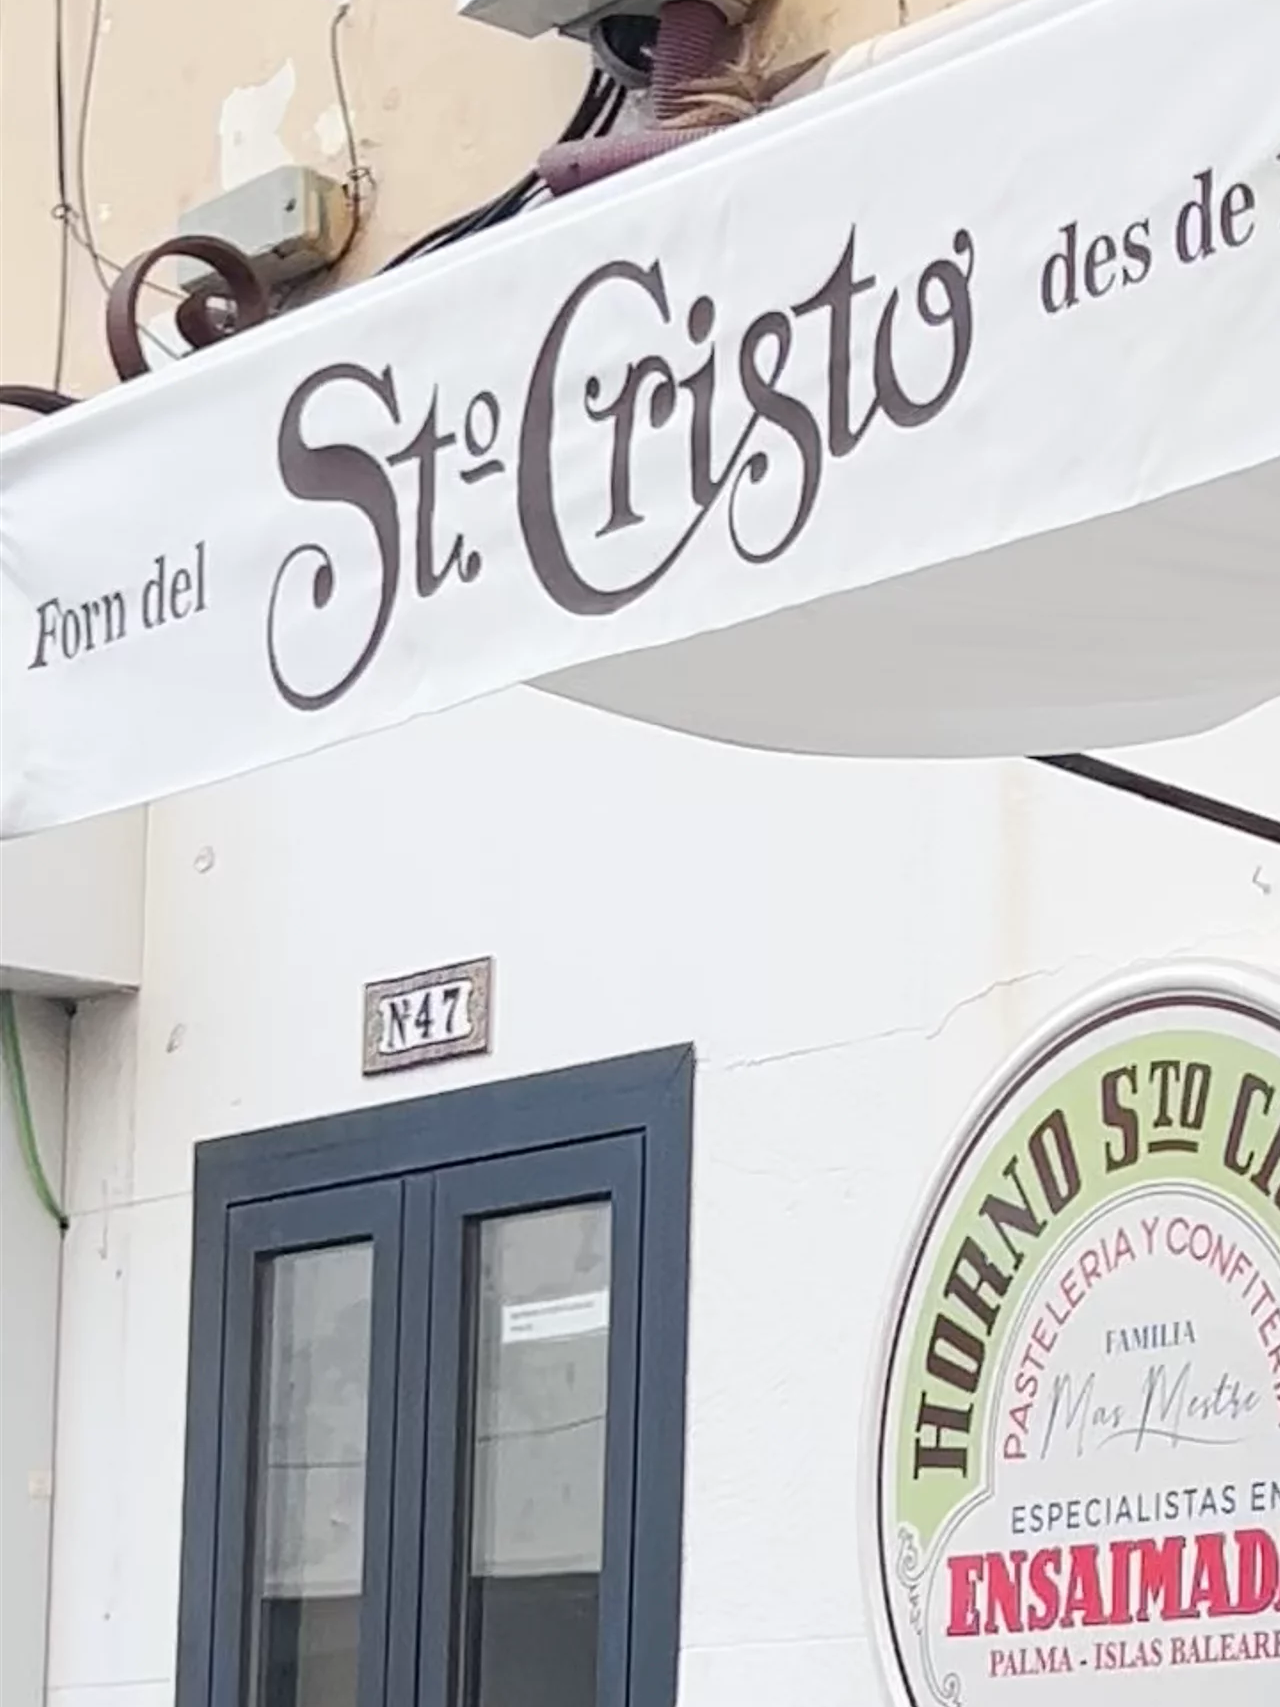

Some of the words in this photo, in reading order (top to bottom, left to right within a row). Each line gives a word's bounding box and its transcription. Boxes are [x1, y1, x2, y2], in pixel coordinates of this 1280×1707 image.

[28, 596, 126, 670] Forn
[142, 540, 206, 630] del
[516, 224, 975, 617] Cristo
[1041, 220, 1153, 314] des
[1175, 167, 1256, 264] de
[911, 1107, 1082, 1481] HORNO
[1003, 1226, 1136, 1461] PASTELERIA
[1141, 1216, 1160, 1255] Y
[1105, 1319, 1197, 1355] FAMILIA
[1011, 1484, 1237, 1535] ESPECIALISTAS
[989, 1645, 1074, 1678] PALMA
[1094, 1636, 1164, 1671] ISLAS
